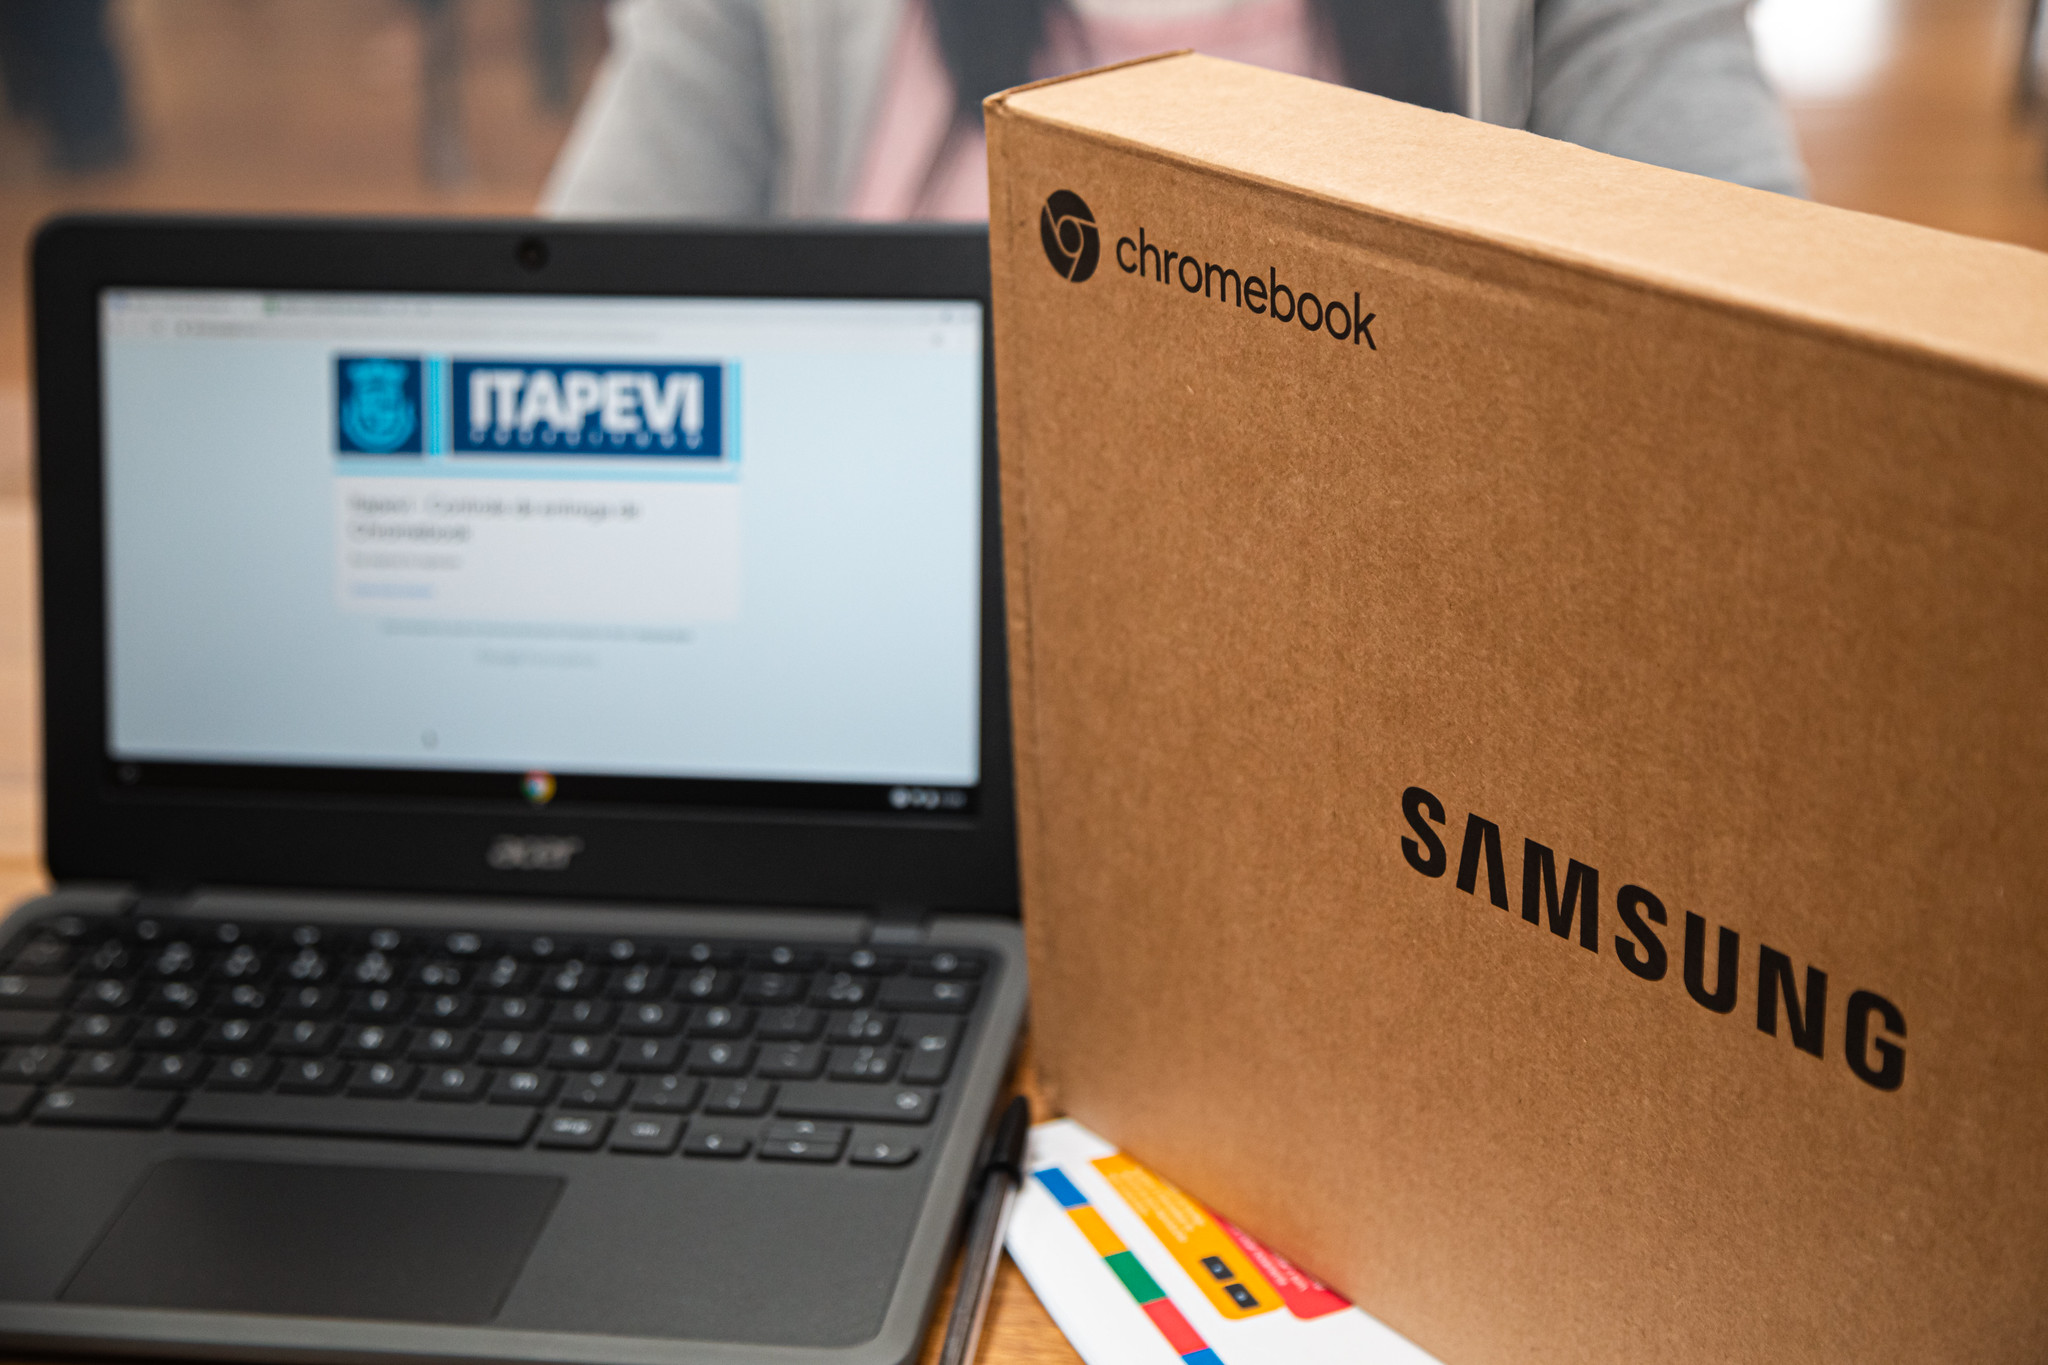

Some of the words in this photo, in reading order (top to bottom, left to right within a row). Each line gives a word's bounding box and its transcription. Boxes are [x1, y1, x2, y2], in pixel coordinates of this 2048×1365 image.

[1115, 226, 1377, 351] chromebook
[469, 368, 704, 432] ITAPEVI
[486, 834, 582, 870] acer
[1400, 786, 1908, 1093] SAMSUNG
